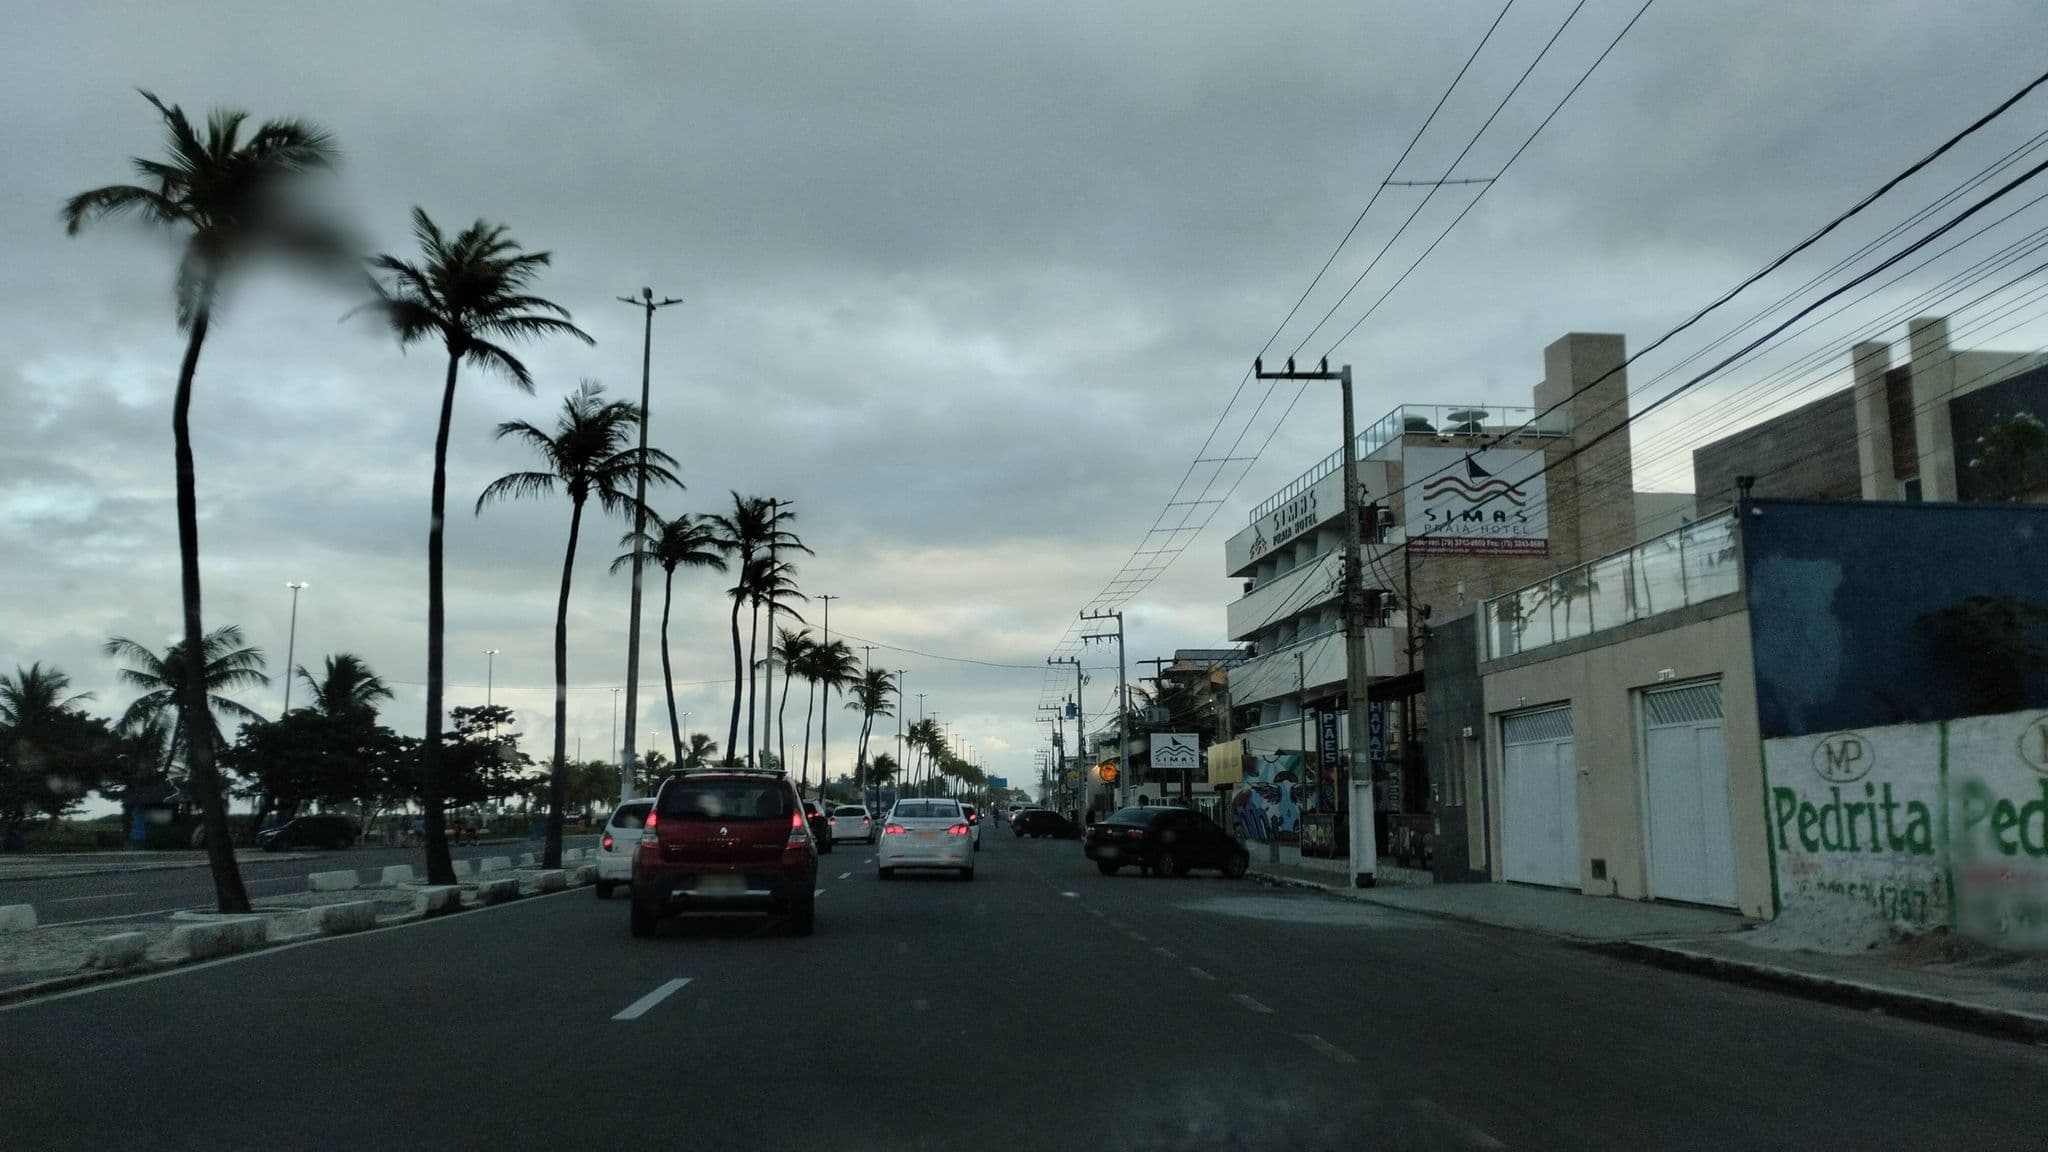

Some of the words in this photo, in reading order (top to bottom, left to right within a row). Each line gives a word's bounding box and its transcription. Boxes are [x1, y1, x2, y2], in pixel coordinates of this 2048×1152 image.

[1424, 507, 1528, 523] SIMAS
[1424, 523, 1471, 534] PRAIA
[1480, 524, 1528, 535] HOTEL
[1823, 740, 1863, 776] MP
[1773, 781, 1935, 855] Pedrita
